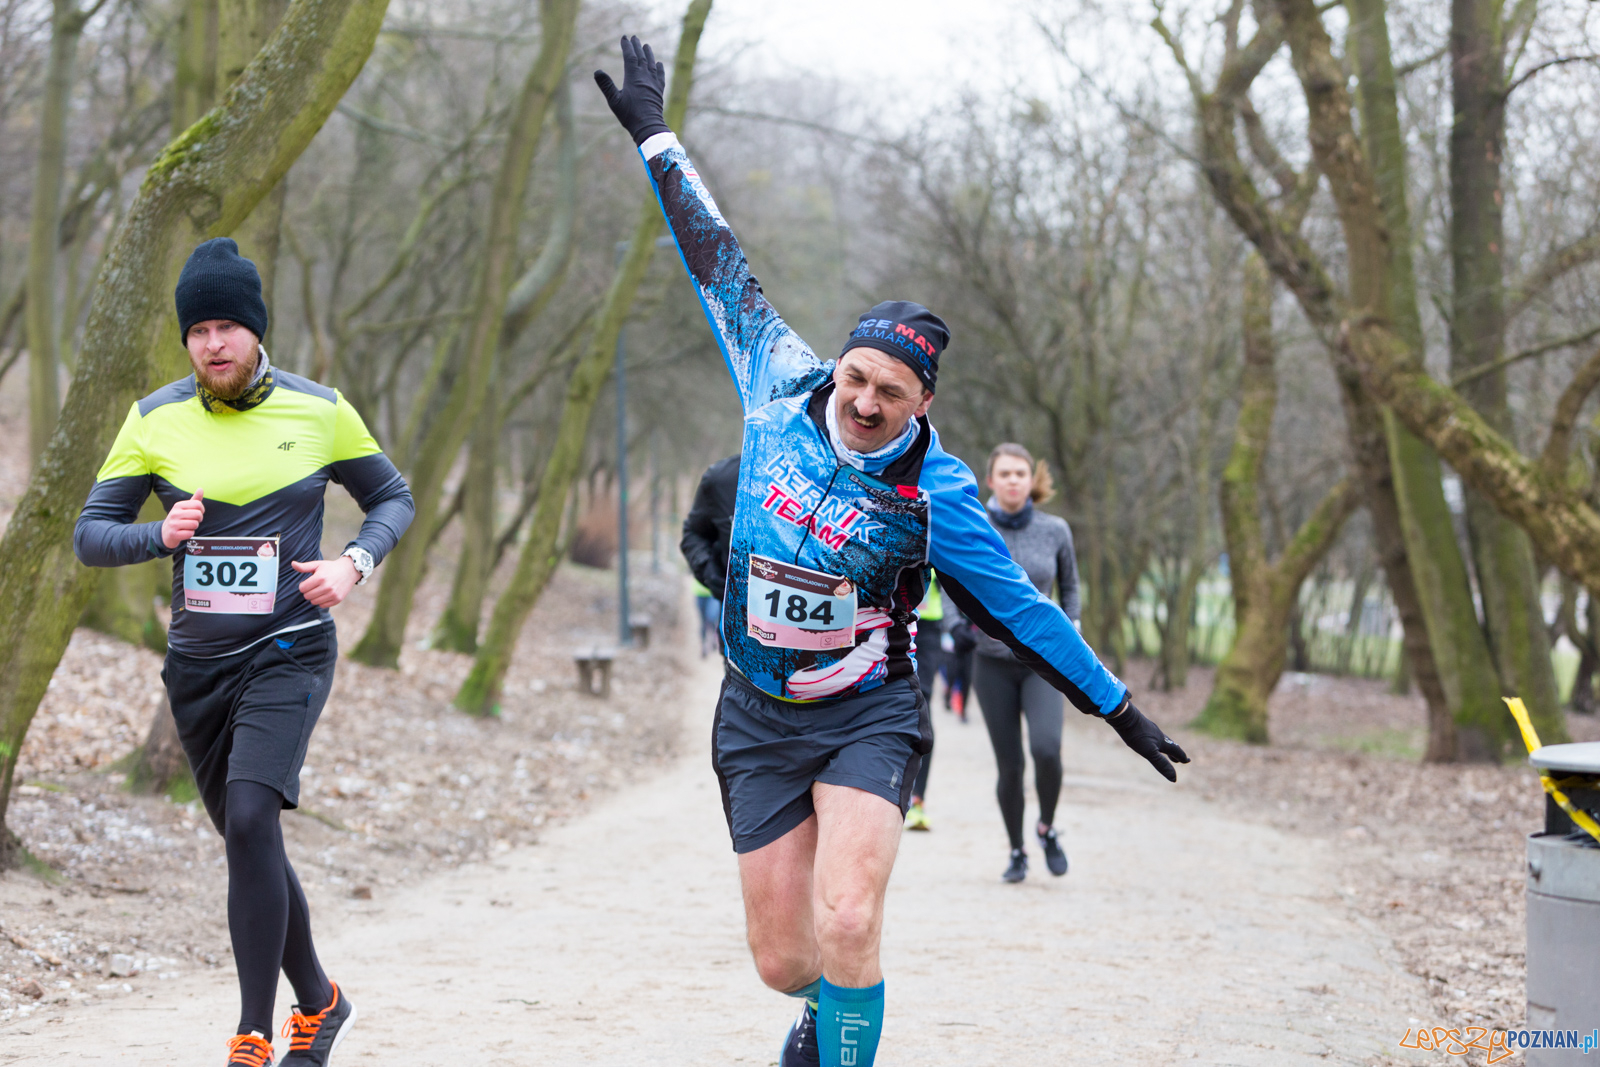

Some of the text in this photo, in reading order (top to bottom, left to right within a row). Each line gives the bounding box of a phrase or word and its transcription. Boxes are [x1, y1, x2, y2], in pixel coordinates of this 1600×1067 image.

[857, 318, 936, 356] ICE MAT
[277, 441, 297, 451] 4F
[765, 451, 887, 544] HERNIK
[761, 481, 853, 553] TEAM
[195, 561, 258, 587] 302
[765, 589, 834, 625] 184
